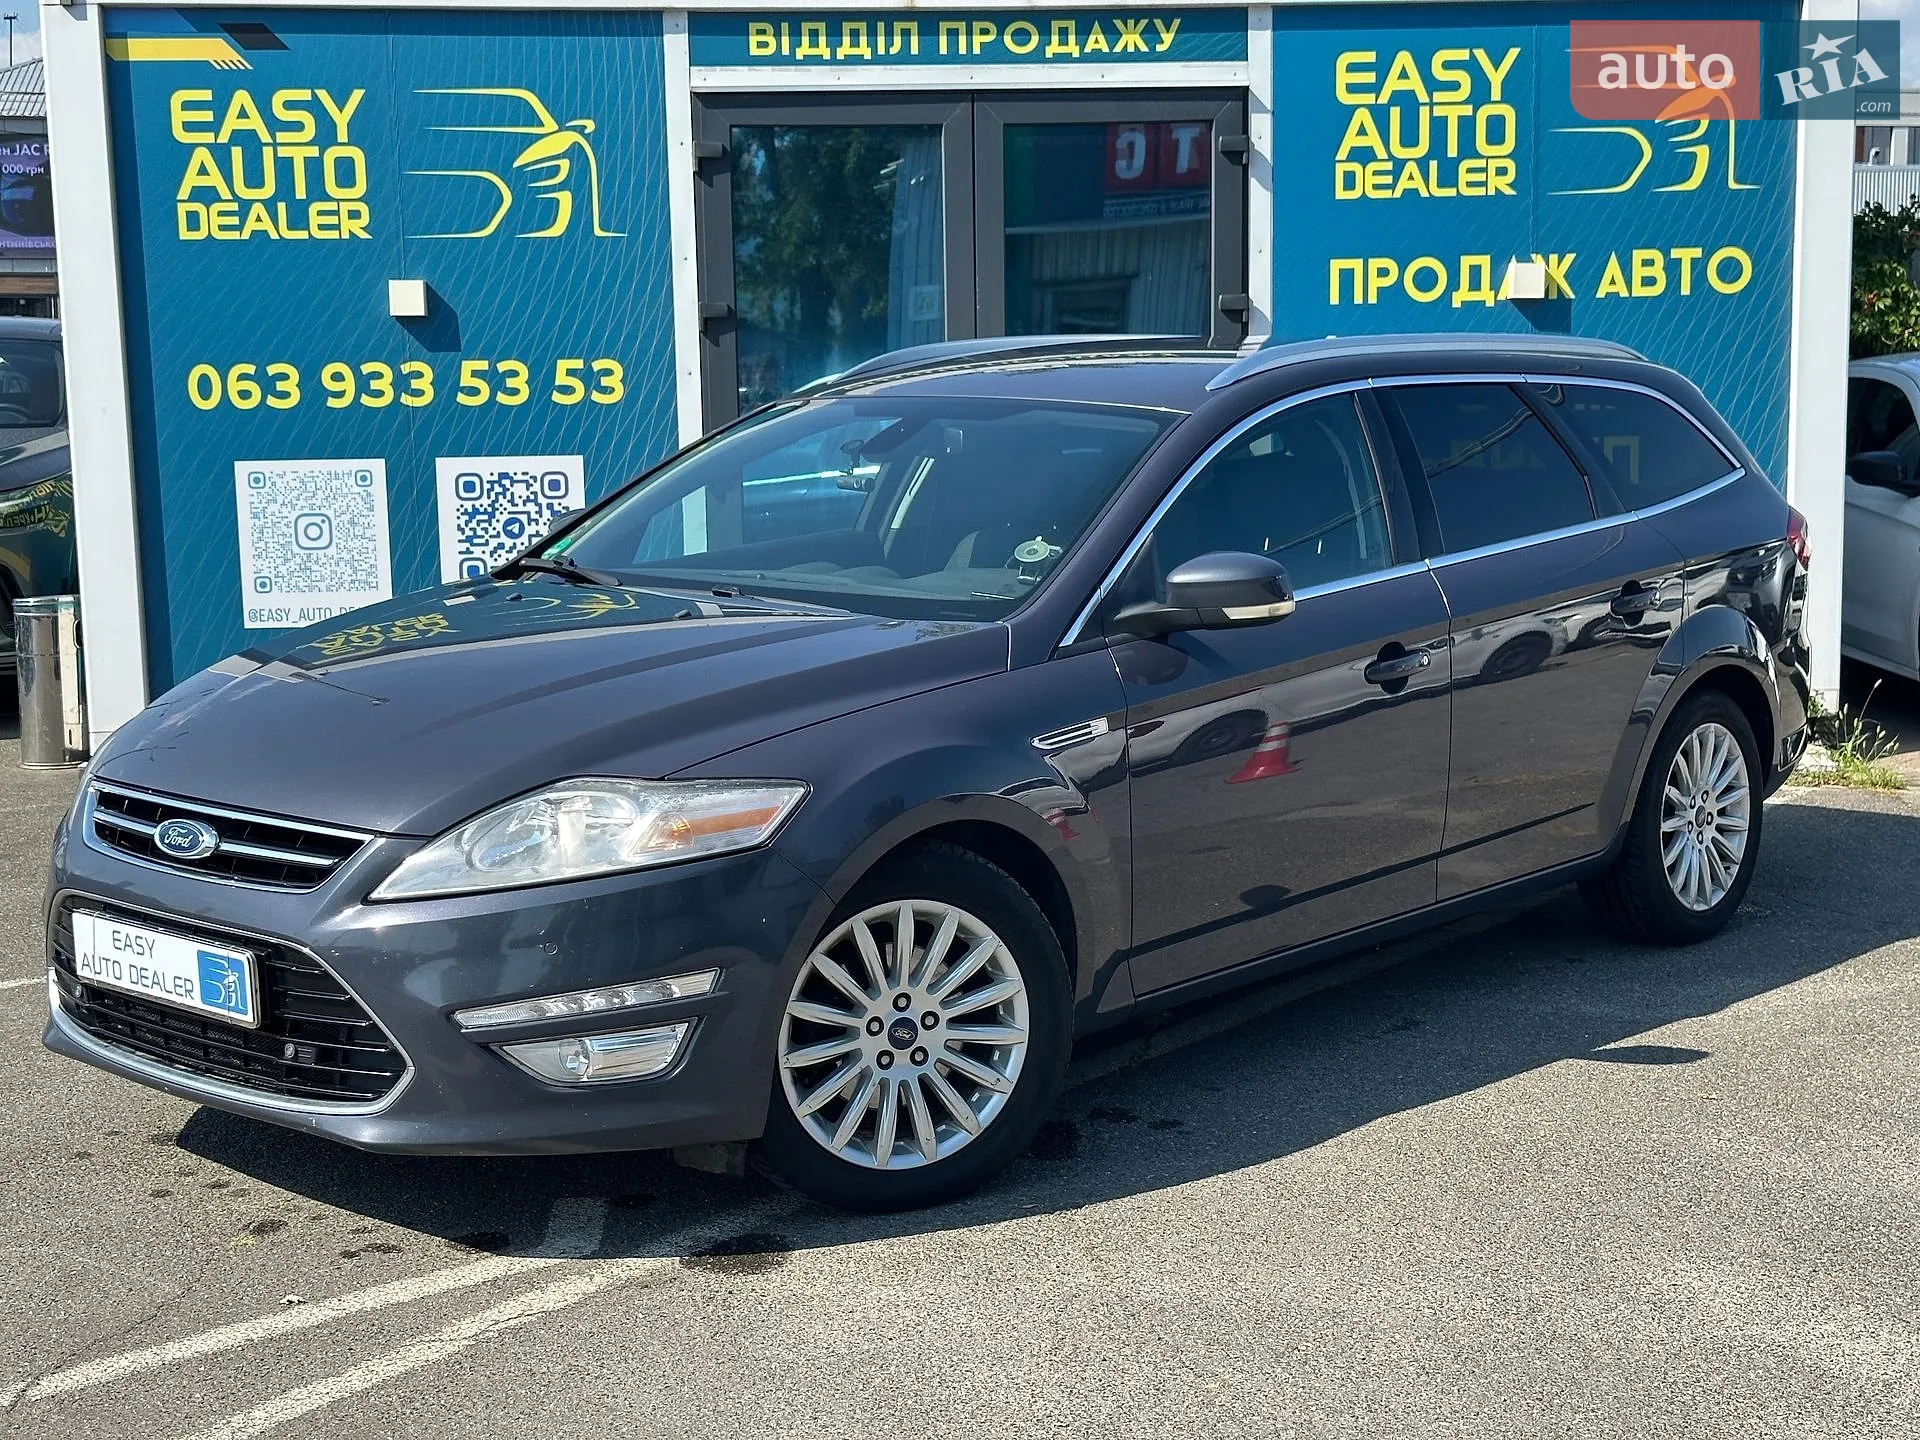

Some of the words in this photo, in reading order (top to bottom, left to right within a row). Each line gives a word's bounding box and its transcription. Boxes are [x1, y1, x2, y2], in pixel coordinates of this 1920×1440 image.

[747, 21, 919, 60] ВІДДІЛ
[938, 18, 1182, 58] ПРОДАЖУ
[1334, 47, 1522, 105] EASY
[170, 88, 366, 144] EASY
[1334, 102, 1517, 161] AUTO
[13, 143, 41, 156] JAC
[176, 145, 367, 200] AUTO
[1334, 158, 1517, 200] DEALER
[176, 200, 373, 241] DEALER
[1329, 252, 1577, 308] ПРОДЖ
[1594, 246, 1753, 299] АВТО
[187, 363, 301, 410] 063
[320, 362, 435, 408] 933
[455, 359, 531, 406] 53
[551, 358, 625, 405] 53
[164, 826, 194, 848] Ford
[112, 930, 156, 959] EASY
[81, 952, 123, 981] AUTO
[129, 964, 195, 1000] DEALER
